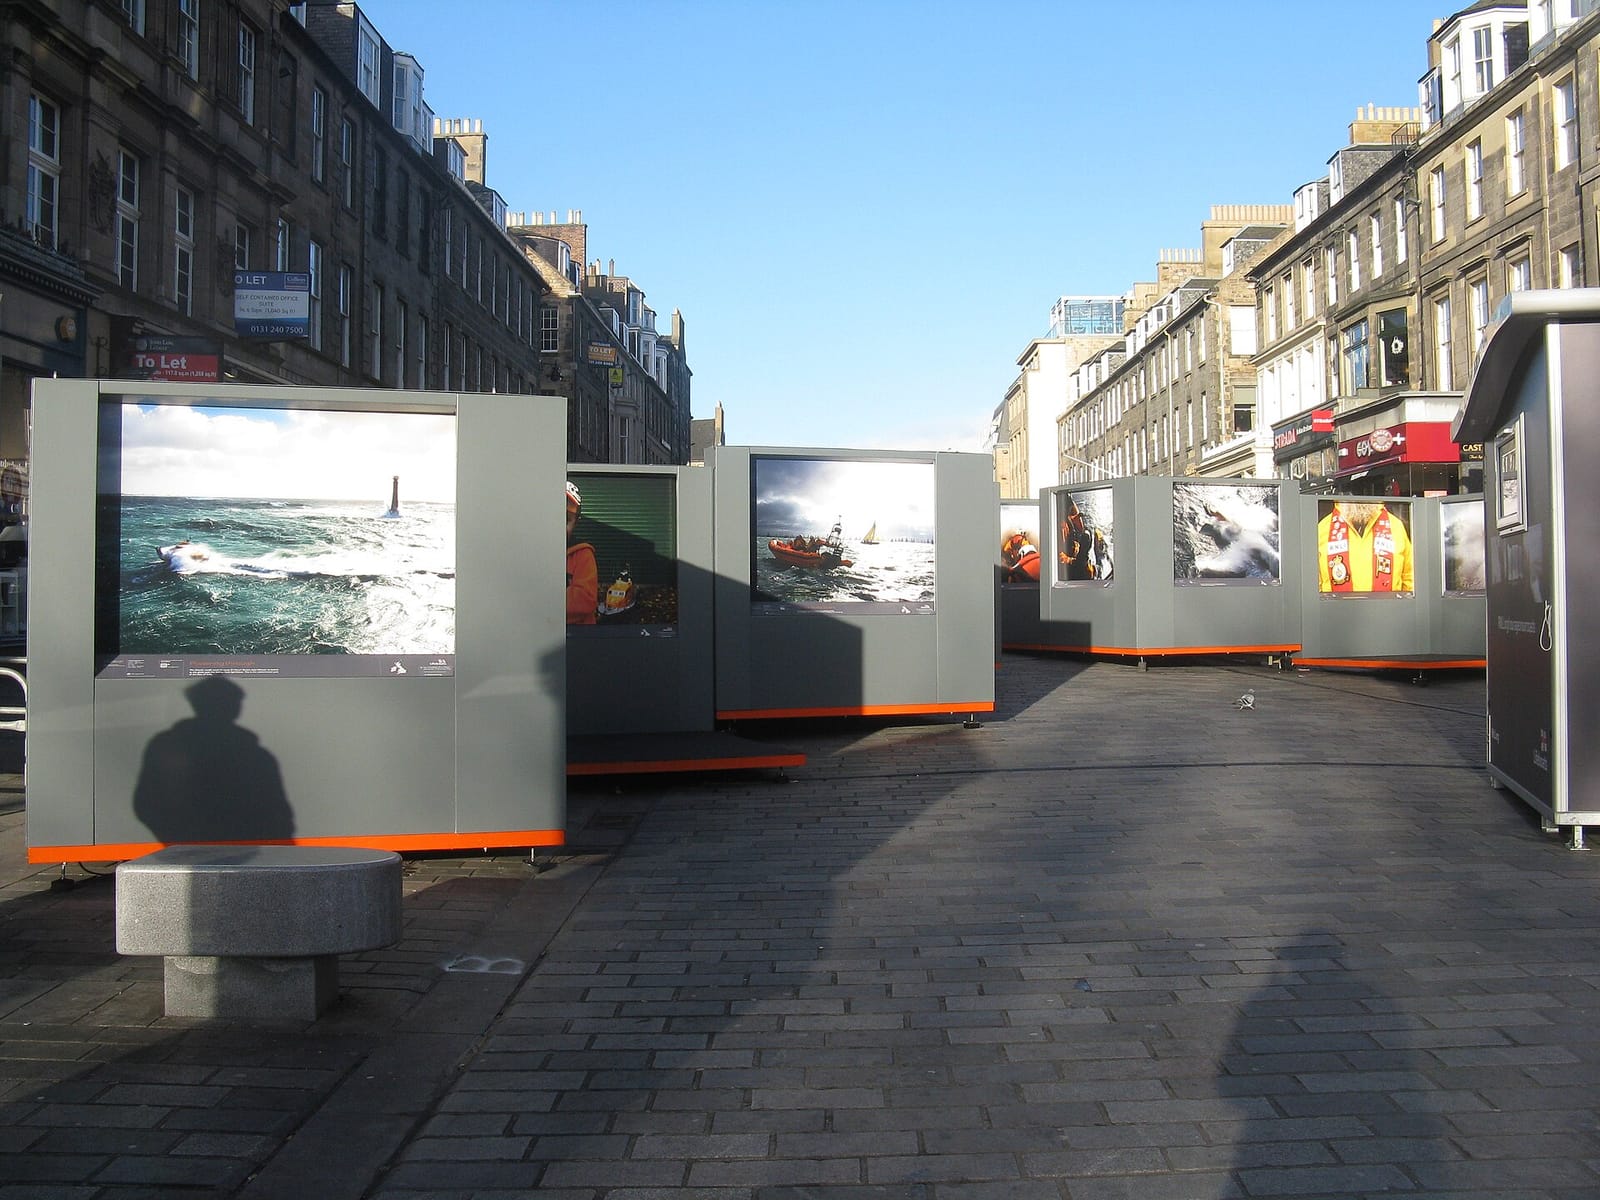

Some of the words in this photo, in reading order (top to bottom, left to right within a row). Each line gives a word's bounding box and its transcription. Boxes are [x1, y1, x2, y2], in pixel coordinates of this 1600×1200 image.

[246, 276, 267, 285] LET
[250, 325, 269, 333] 0131
[285, 326, 304, 334] 7500
[135, 354, 155, 368] To
[160, 355, 187, 370] Let
[1274, 427, 1297, 450] STRADA
